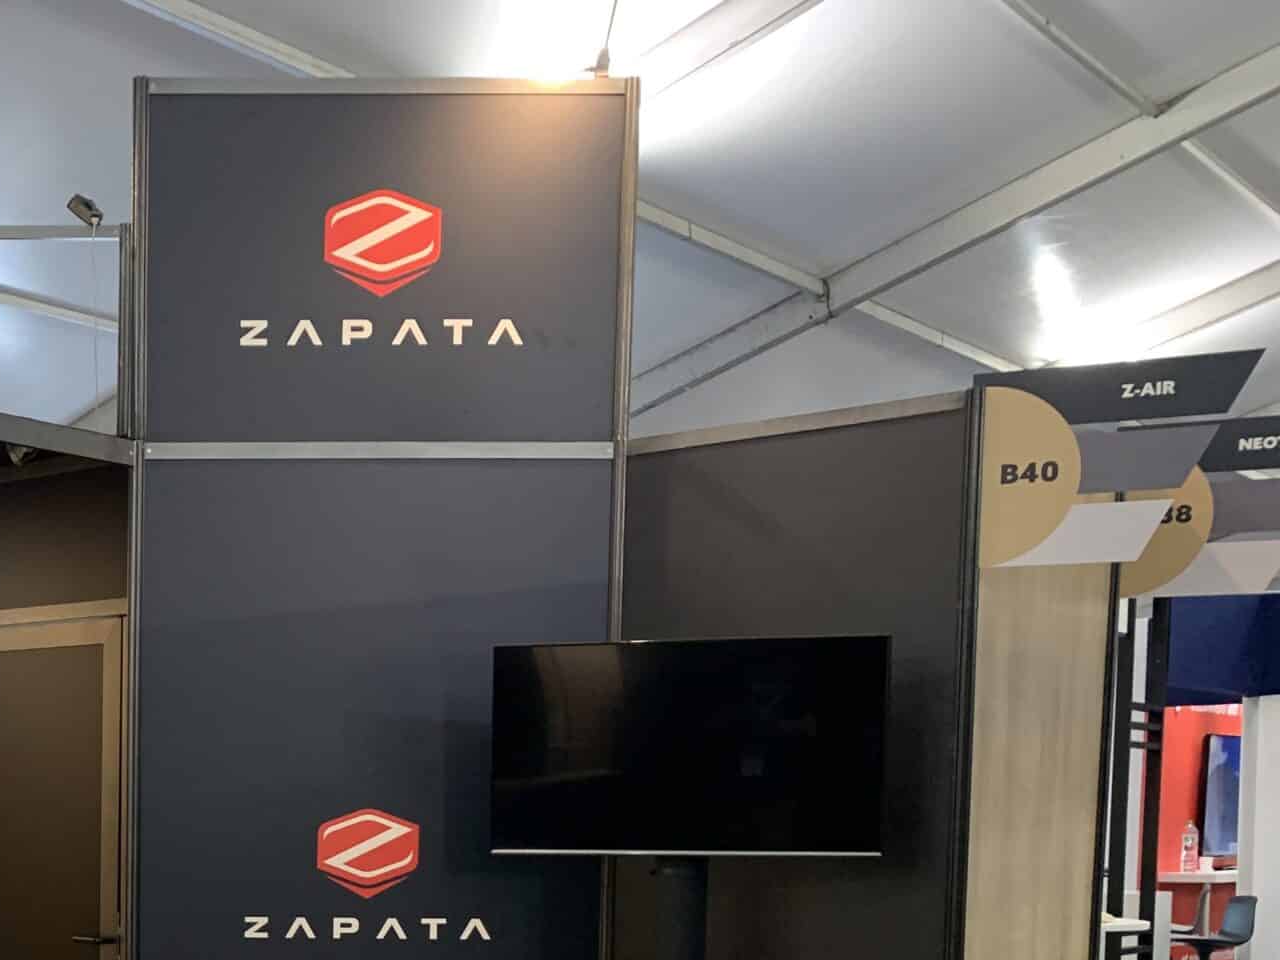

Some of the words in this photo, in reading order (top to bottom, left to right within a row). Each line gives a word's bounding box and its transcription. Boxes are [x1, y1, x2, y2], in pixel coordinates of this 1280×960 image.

[239, 318, 524, 346] ZAPATA
[1121, 380, 1175, 399] Z-AIR
[1238, 435, 1280, 451] NEO
[1000, 461, 1059, 485] B40
[244, 916, 491, 940] ZAPATA
